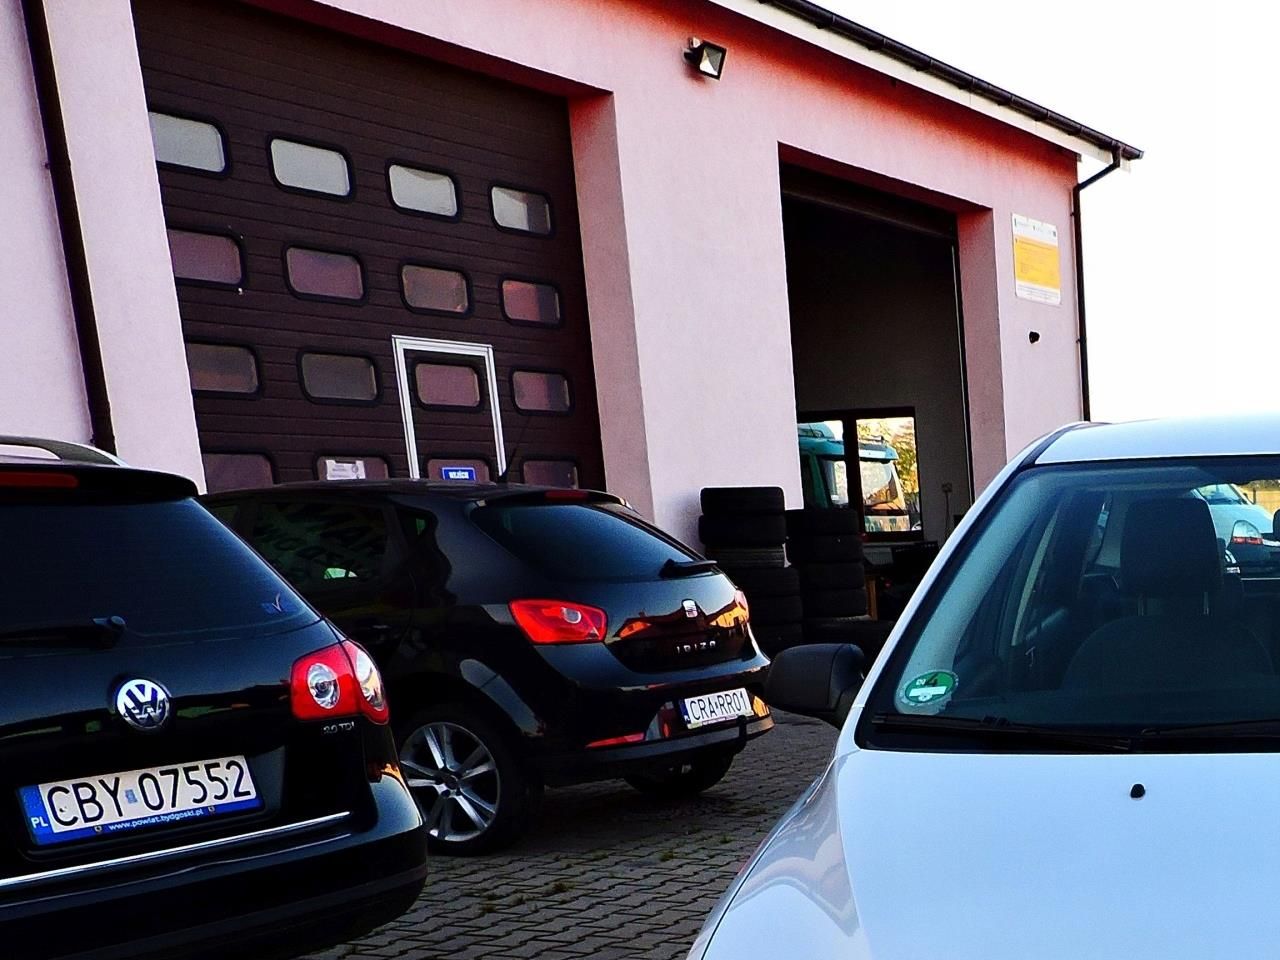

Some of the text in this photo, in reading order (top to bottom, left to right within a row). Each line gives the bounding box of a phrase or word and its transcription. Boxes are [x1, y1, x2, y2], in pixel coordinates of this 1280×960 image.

[690, 690, 747, 720] CRA RR01
[47, 760, 251, 827] CBY 07552
[31, 816, 49, 829] PL
[108, 808, 204, 831] www.powiat.bydgoski.pl
